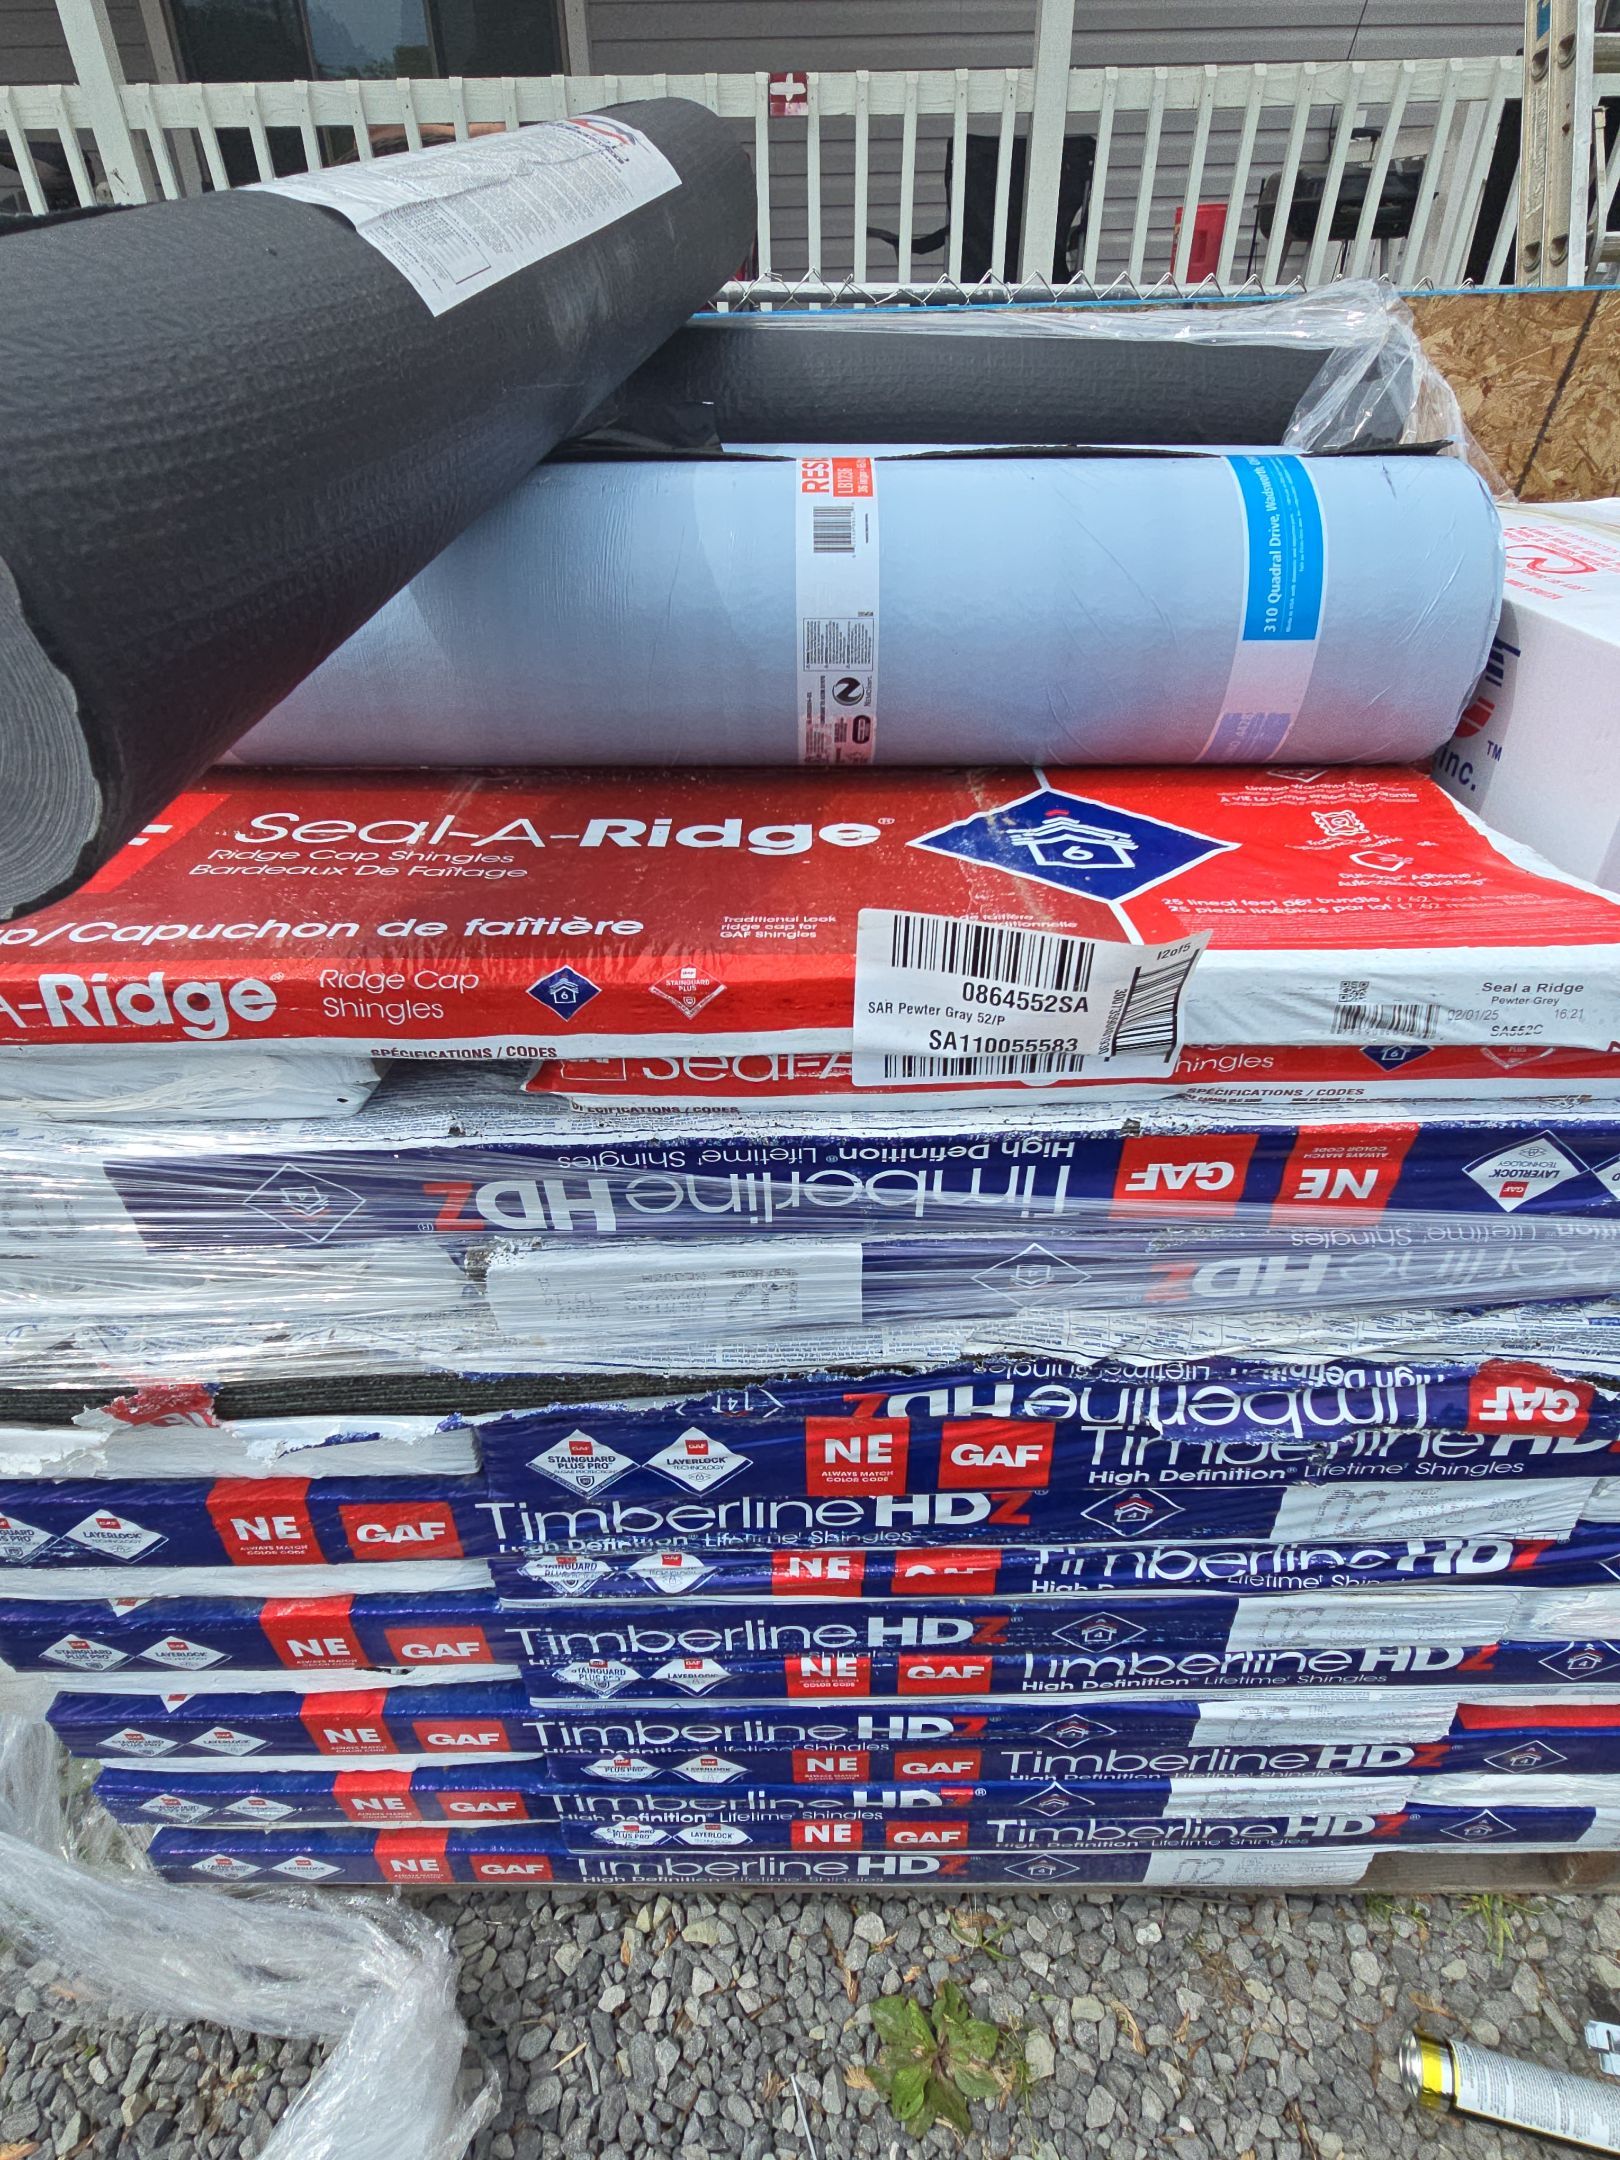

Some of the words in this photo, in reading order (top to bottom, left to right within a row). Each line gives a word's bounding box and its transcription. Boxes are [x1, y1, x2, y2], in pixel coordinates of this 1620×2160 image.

[1268, 513, 1282, 547] Drive,
[1267, 550, 1283, 604] Quadral
[1263, 607, 1279, 633] 310
[207, 848, 300, 864] Ridge
[322, 848, 383, 865] Cap
[388, 848, 515, 866] Shingles
[189, 864, 345, 876] Bardeaux
[353, 864, 402, 878] De
[406, 863, 528, 881] Faîtage
[720, 923, 754, 934] ridge
[793, 923, 819, 932] for
[722, 915, 802, 925] Traditional
[804, 915, 837, 925] Look
[0, 920, 361, 947] p/Capuchon
[376, 918, 448, 937] de
[463, 917, 644, 938] faîtière
[719, 931, 751, 939] GAF
[754, 930, 818, 941] Shingles
[318, 968, 405, 994] Ridge
[413, 969, 480, 995] Cap
[1481, 982, 1518, 993] Seal
[1521, 984, 1532, 993] a
[1535, 982, 1585, 995] Ridge
[961, 980, 1090, 1014] 0864552SA
[1490, 995, 1532, 1005] Pewter
[1533, 996, 1561, 1007] Grey
[322, 997, 444, 1027] Shingles
[867, 1001, 894, 1015] SAR
[897, 1001, 942, 1019] Pewter
[944, 1007, 974, 1026] Gray
[977, 1010, 1006, 1026] 52/P
[928, 1029, 1079, 1054] SA110055583
[506, 1045, 558, 1059] CODES
[1175, 1053, 1275, 1074] hingles
[1316, 1087, 1366, 1098] CODES
[557, 1148, 686, 1169] Shingles
[1001, 1140, 1075, 1158] High
[1125, 1161, 1236, 1192] GAF
[1293, 1168, 1379, 1200] NE
[625, 1164, 1080, 1224] Timberline
[1503, 1185, 1525, 1194] GAF
[1292, 1229, 1413, 1248] Shingles
[1478, 1386, 1581, 1424] GAF
[547, 1455, 616, 1463] STAINGUARD
[824, 1434, 893, 1464] NE
[950, 1443, 1043, 1468] GAF
[557, 1462, 583, 1470] PLUS
[1088, 1469, 1150, 1486] High
[1415, 1461, 1525, 1477] Shingles
[474, 1496, 865, 1543] Timberline
[874, 1492, 1032, 1528] HDZ
[229, 1515, 302, 1542] NE
[356, 1521, 446, 1544] GAF
[789, 1556, 850, 1580] NE
[504, 1619, 858, 1656] Timberline
[867, 1615, 1010, 1648] HDZ
[286, 1637, 350, 1658] NE
[401, 1641, 480, 1659] GAF
[800, 1657, 857, 1677] NE
[1358, 1643, 1500, 1673] HDZ
[907, 1665, 985, 1679] GAF
[1022, 1680, 1073, 1692] High
[1296, 1673, 1387, 1685] Shingles
[323, 1728, 381, 1744] NE
[427, 1733, 500, 1745] GAF
[522, 1720, 849, 1747] Timberline
[857, 1715, 989, 1739] HDZ
[806, 1757, 858, 1772] NE
[902, 1761, 974, 1775] GAF
[1001, 1749, 1310, 1773] Timberline
[1315, 1745, 1452, 1769] HDZ
[351, 1798, 407, 1811] NE
[450, 1801, 517, 1813] GAF
[802, 1809, 884, 1821] Shingles
[690, 1831, 733, 1839] LAYERLOCK
[804, 1823, 852, 1843] NE
[893, 1831, 961, 1844] GAF
[986, 1818, 1278, 1843] Timberline
[390, 1859, 440, 1872] NE
[480, 1864, 544, 1875] GAF
[567, 1857, 849, 1877] Timberline
[857, 1855, 972, 1876] HDZ
